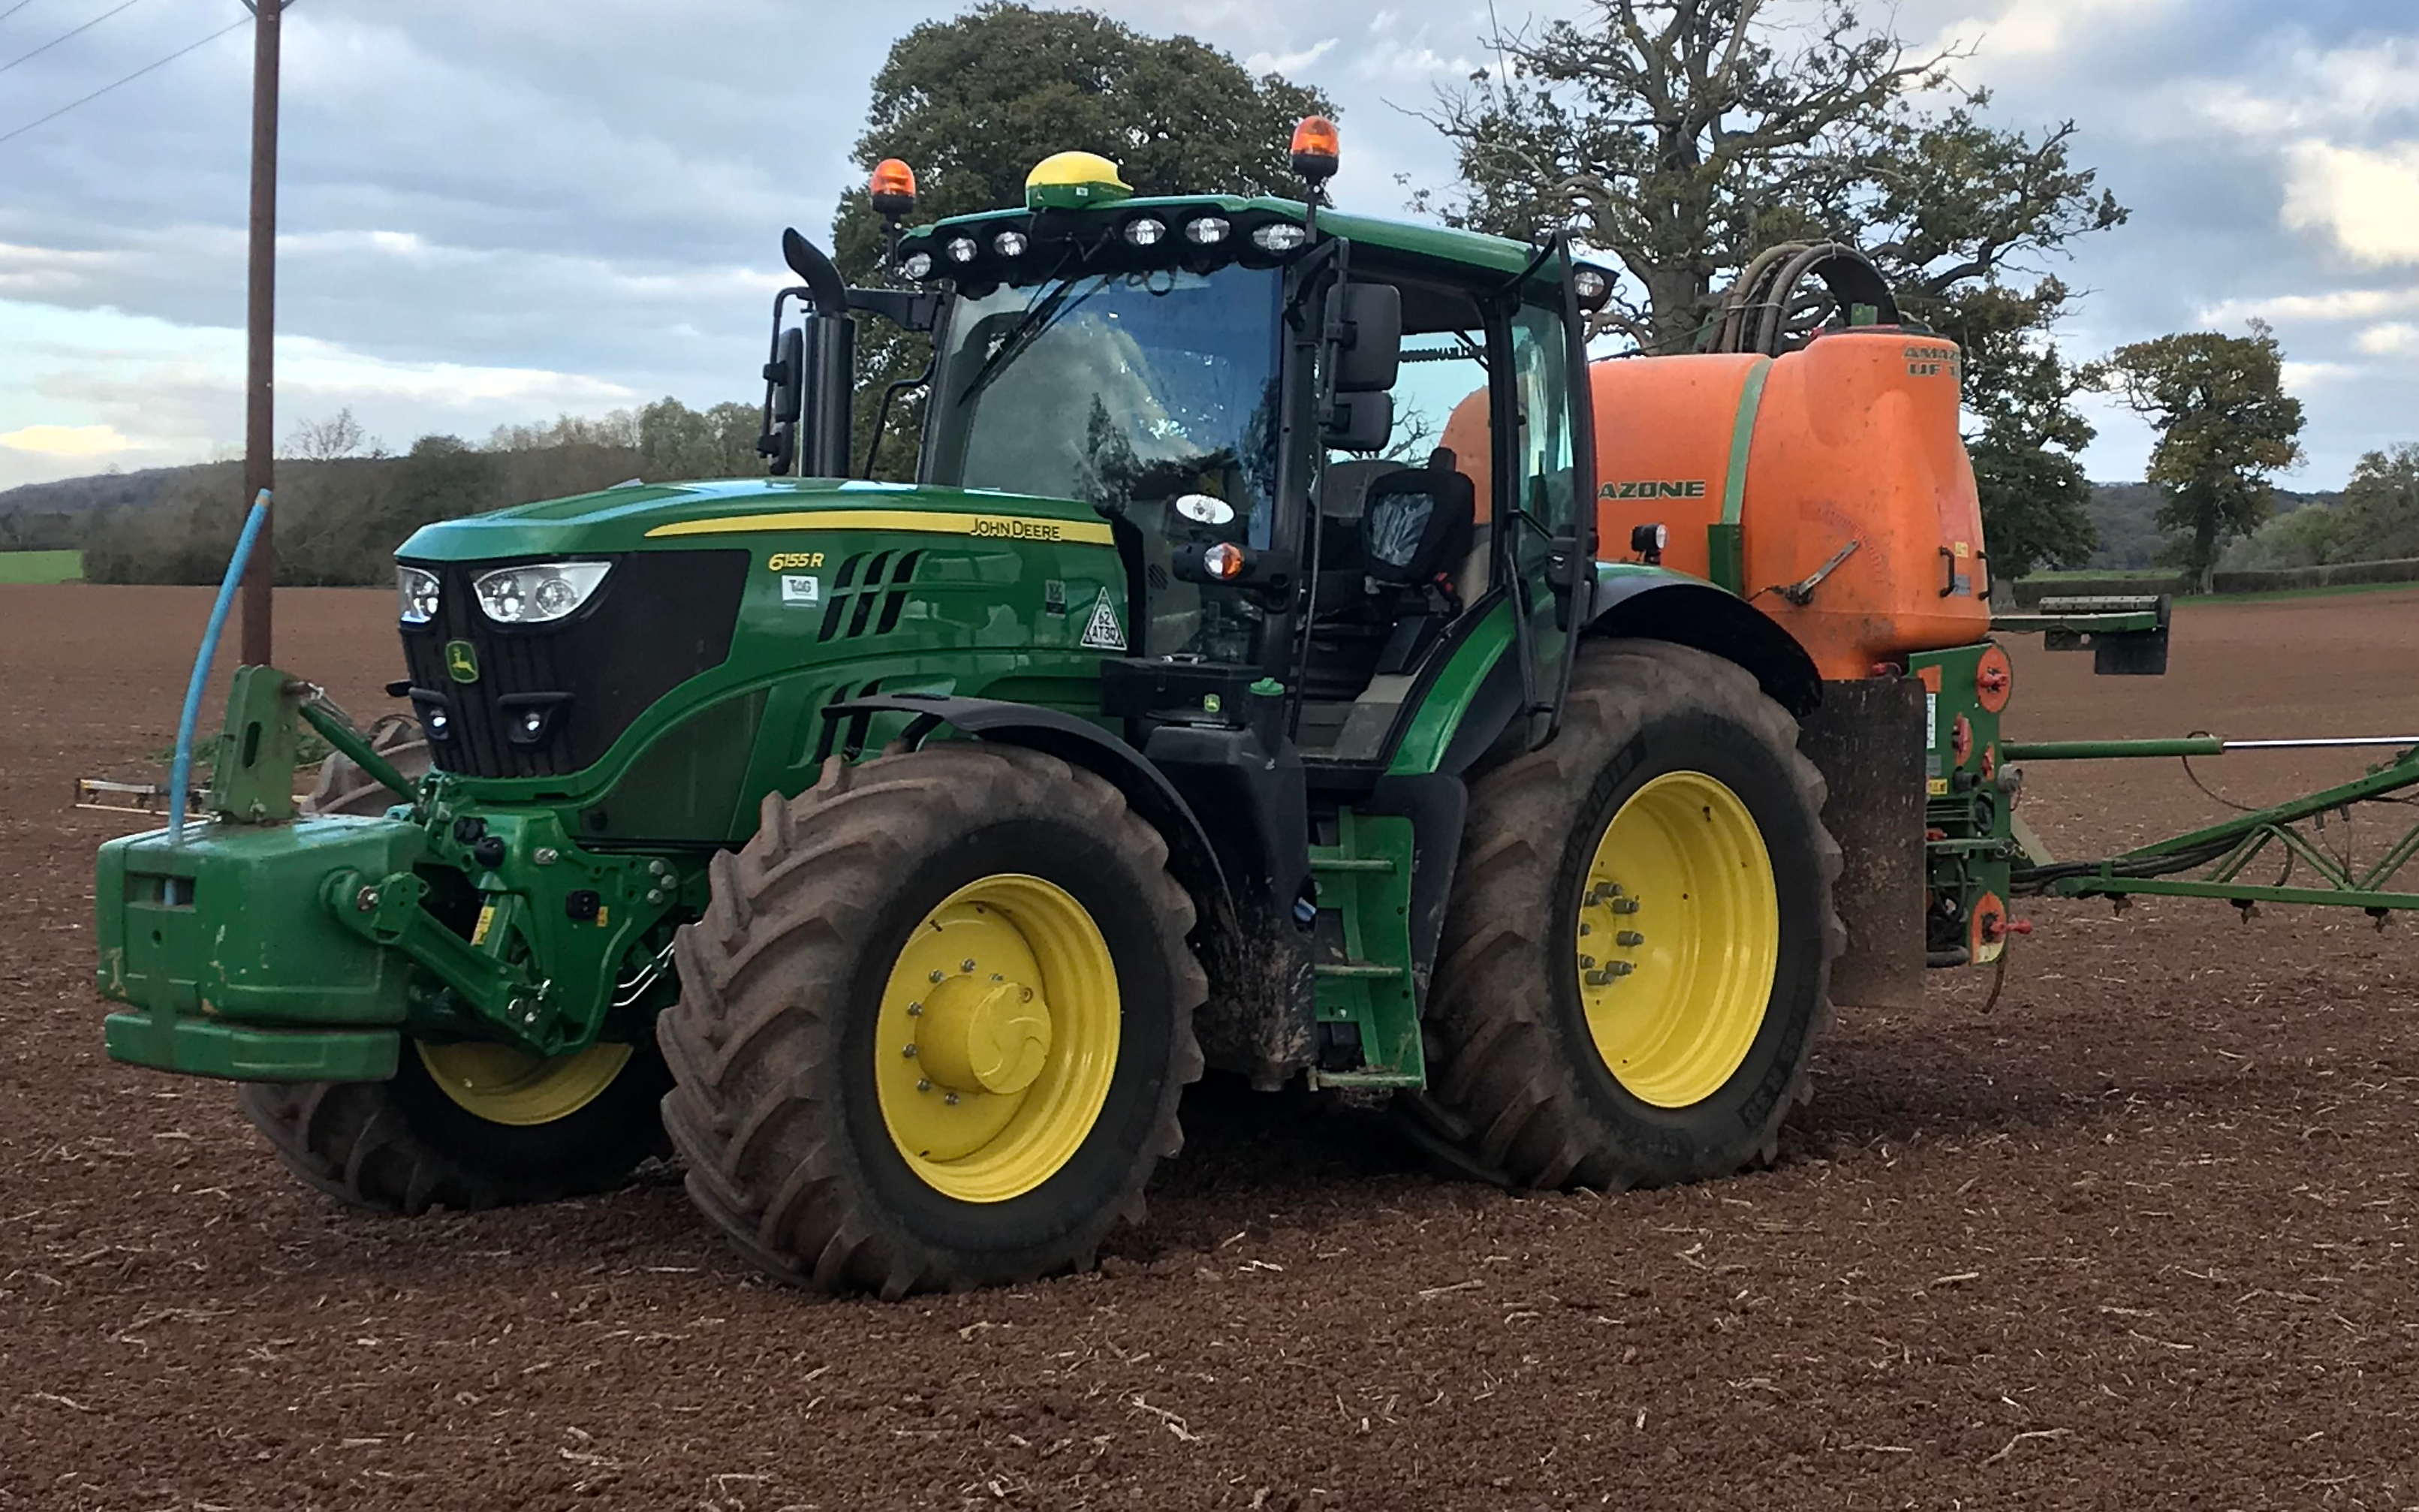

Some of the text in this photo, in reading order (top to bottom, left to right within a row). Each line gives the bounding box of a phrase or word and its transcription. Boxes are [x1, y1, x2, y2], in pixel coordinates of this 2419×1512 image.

[1908, 363, 1942, 376] UF
[970, 517, 1062, 540] JOHN DEERE
[1098, 610, 1110, 625] 62
